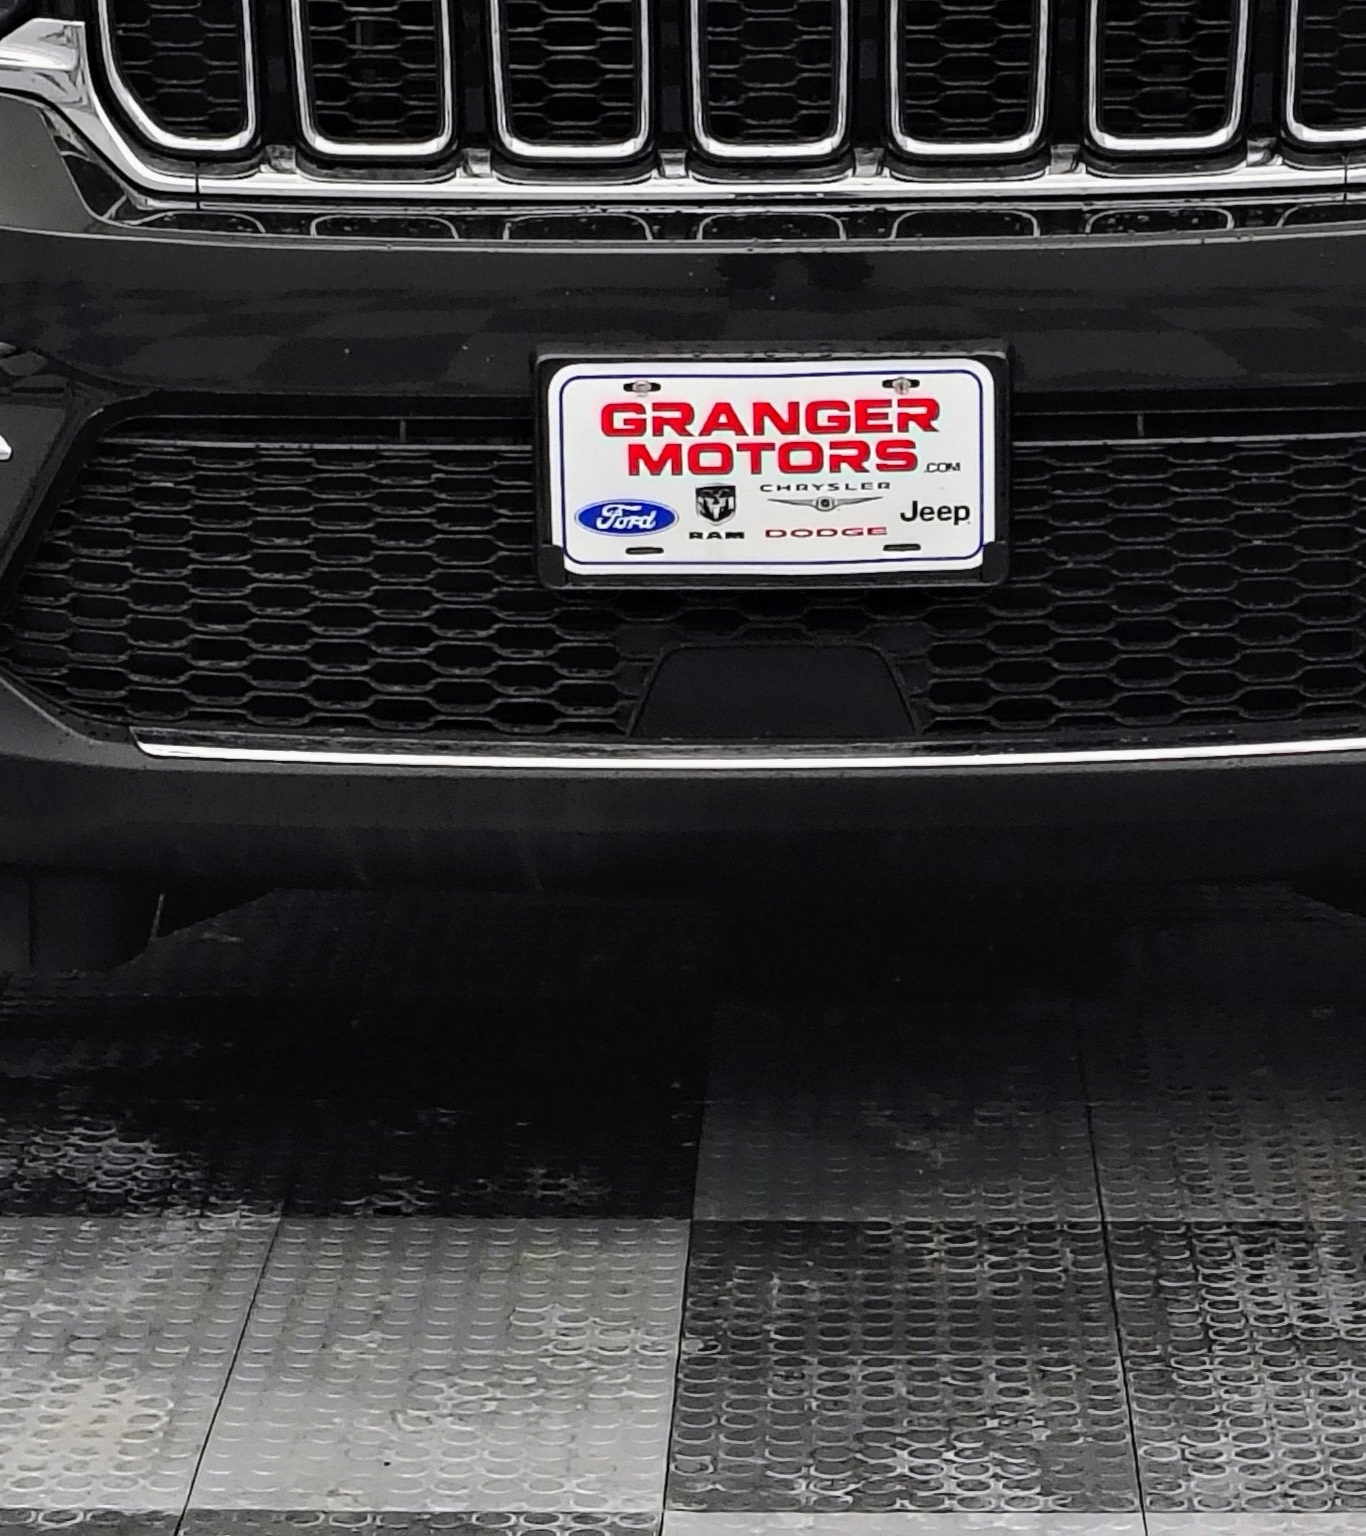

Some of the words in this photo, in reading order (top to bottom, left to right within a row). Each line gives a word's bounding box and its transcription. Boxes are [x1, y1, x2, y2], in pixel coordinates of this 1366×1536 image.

[600, 398, 940, 437] GRANGER
[627, 439, 919, 477] MOTORS
[759, 482, 891, 492] CHRYSLER
[596, 504, 657, 530] Ford
[900, 500, 970, 526] Jeep
[689, 532, 745, 540] RAM
[765, 527, 888, 538] DODGE
